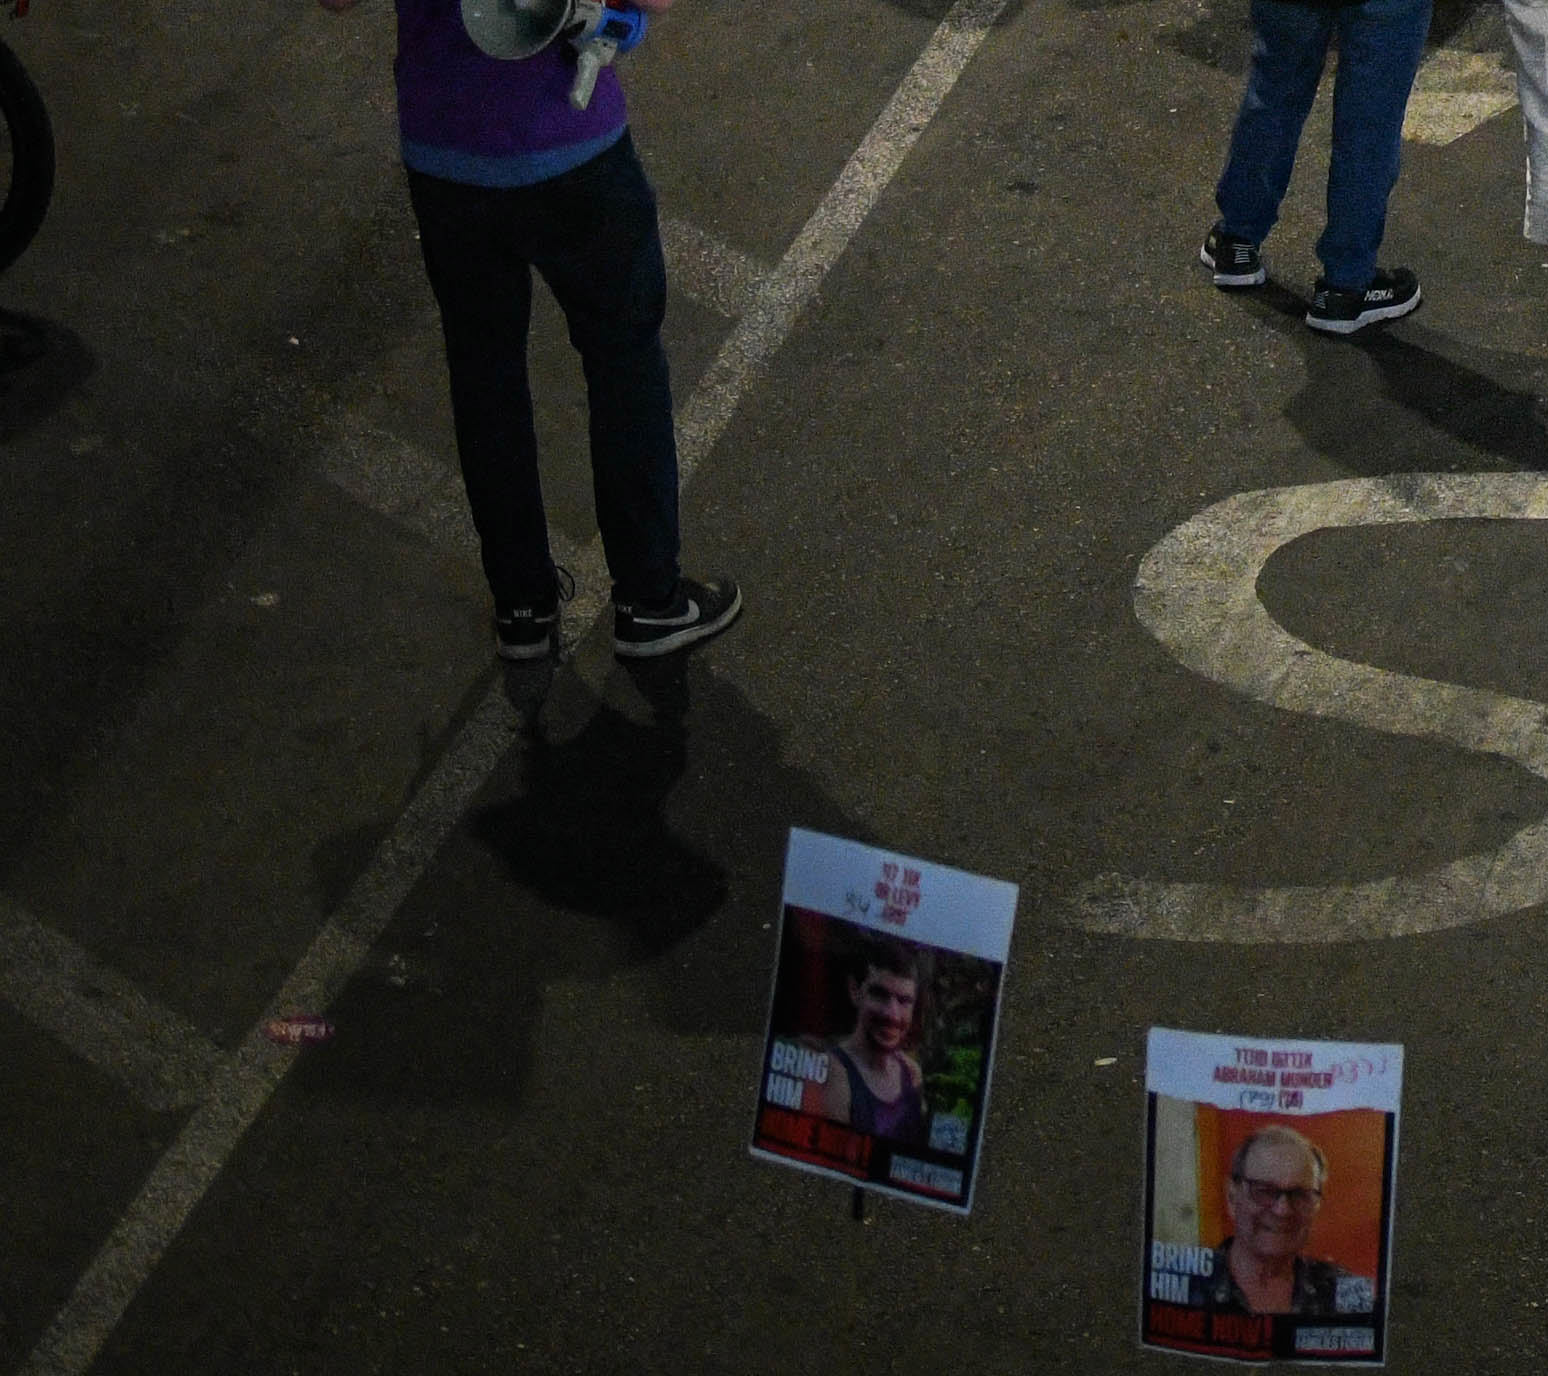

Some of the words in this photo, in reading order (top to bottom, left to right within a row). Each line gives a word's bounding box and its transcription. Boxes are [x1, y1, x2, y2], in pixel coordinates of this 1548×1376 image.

[770, 1041, 829, 1084] BRING
[766, 1073, 805, 1111] HIM
[1151, 1240, 1214, 1278] BRING
[1150, 1270, 1190, 1305] HIM
